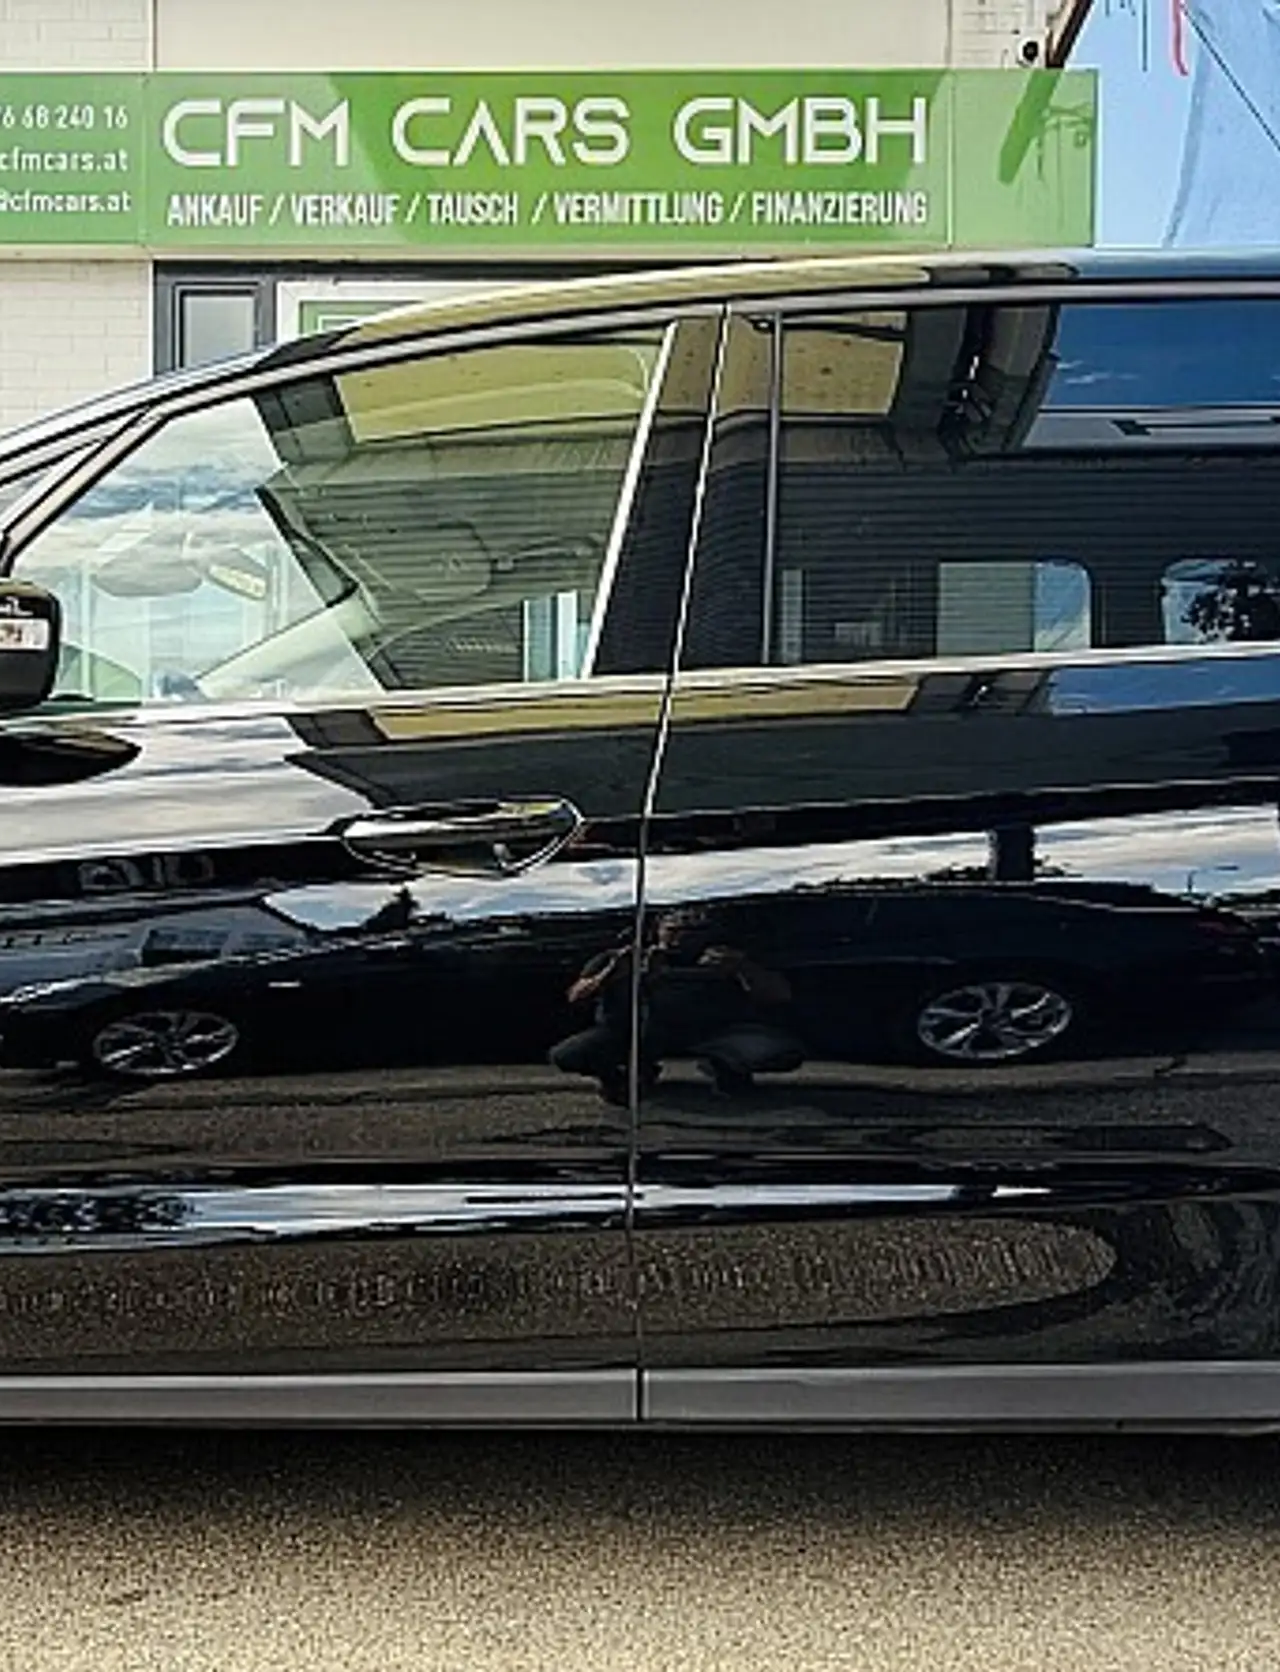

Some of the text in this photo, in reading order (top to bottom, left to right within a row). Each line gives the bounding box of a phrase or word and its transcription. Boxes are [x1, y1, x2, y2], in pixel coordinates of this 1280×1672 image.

[22, 104, 50, 129] 68
[55, 104, 95, 129] 240
[103, 104, 129, 129] 16
[163, 97, 926, 167] CFM CARS GMBH
[167, 193, 264, 226] ANKAUF
[291, 193, 401, 226] VERKAUF
[426, 192, 519, 226] TAUSCH
[554, 191, 723, 225] VERMITTLUNG
[752, 191, 929, 225] FINANZIERUNG
